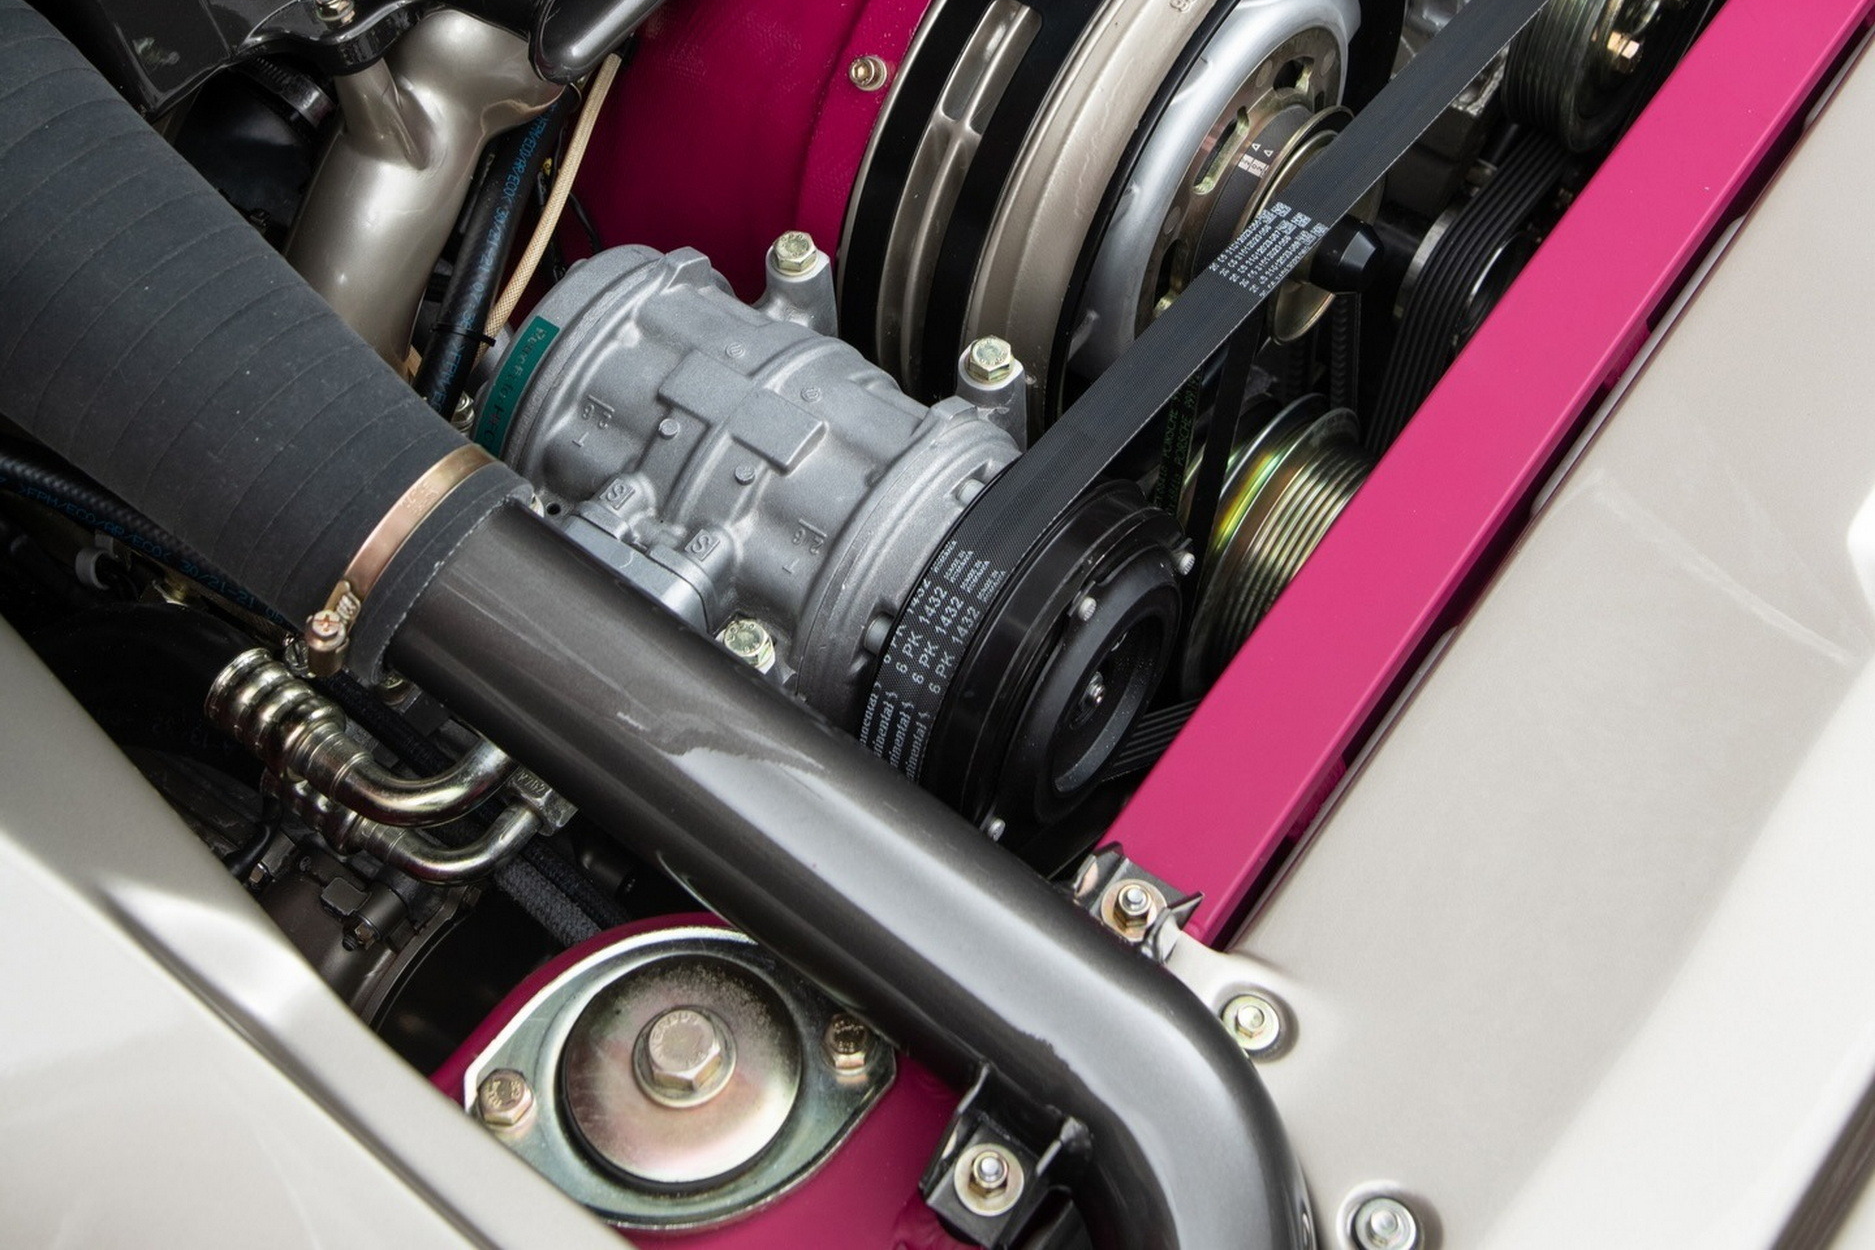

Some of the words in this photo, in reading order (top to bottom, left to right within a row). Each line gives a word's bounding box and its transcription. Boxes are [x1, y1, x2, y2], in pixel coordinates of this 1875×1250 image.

[604, 479, 628, 505] S
[688, 531, 711, 557] S
[917, 585, 948, 626] 1432
[901, 629, 924, 658] PK
[909, 671, 926, 685] 6
[918, 641, 939, 668] PK
[933, 595, 965, 636] 1432
[926, 681, 942, 695] 6
[934, 651, 956, 678] PK
[950, 605, 980, 646] 1432
[894, 660, 910, 674] 6
